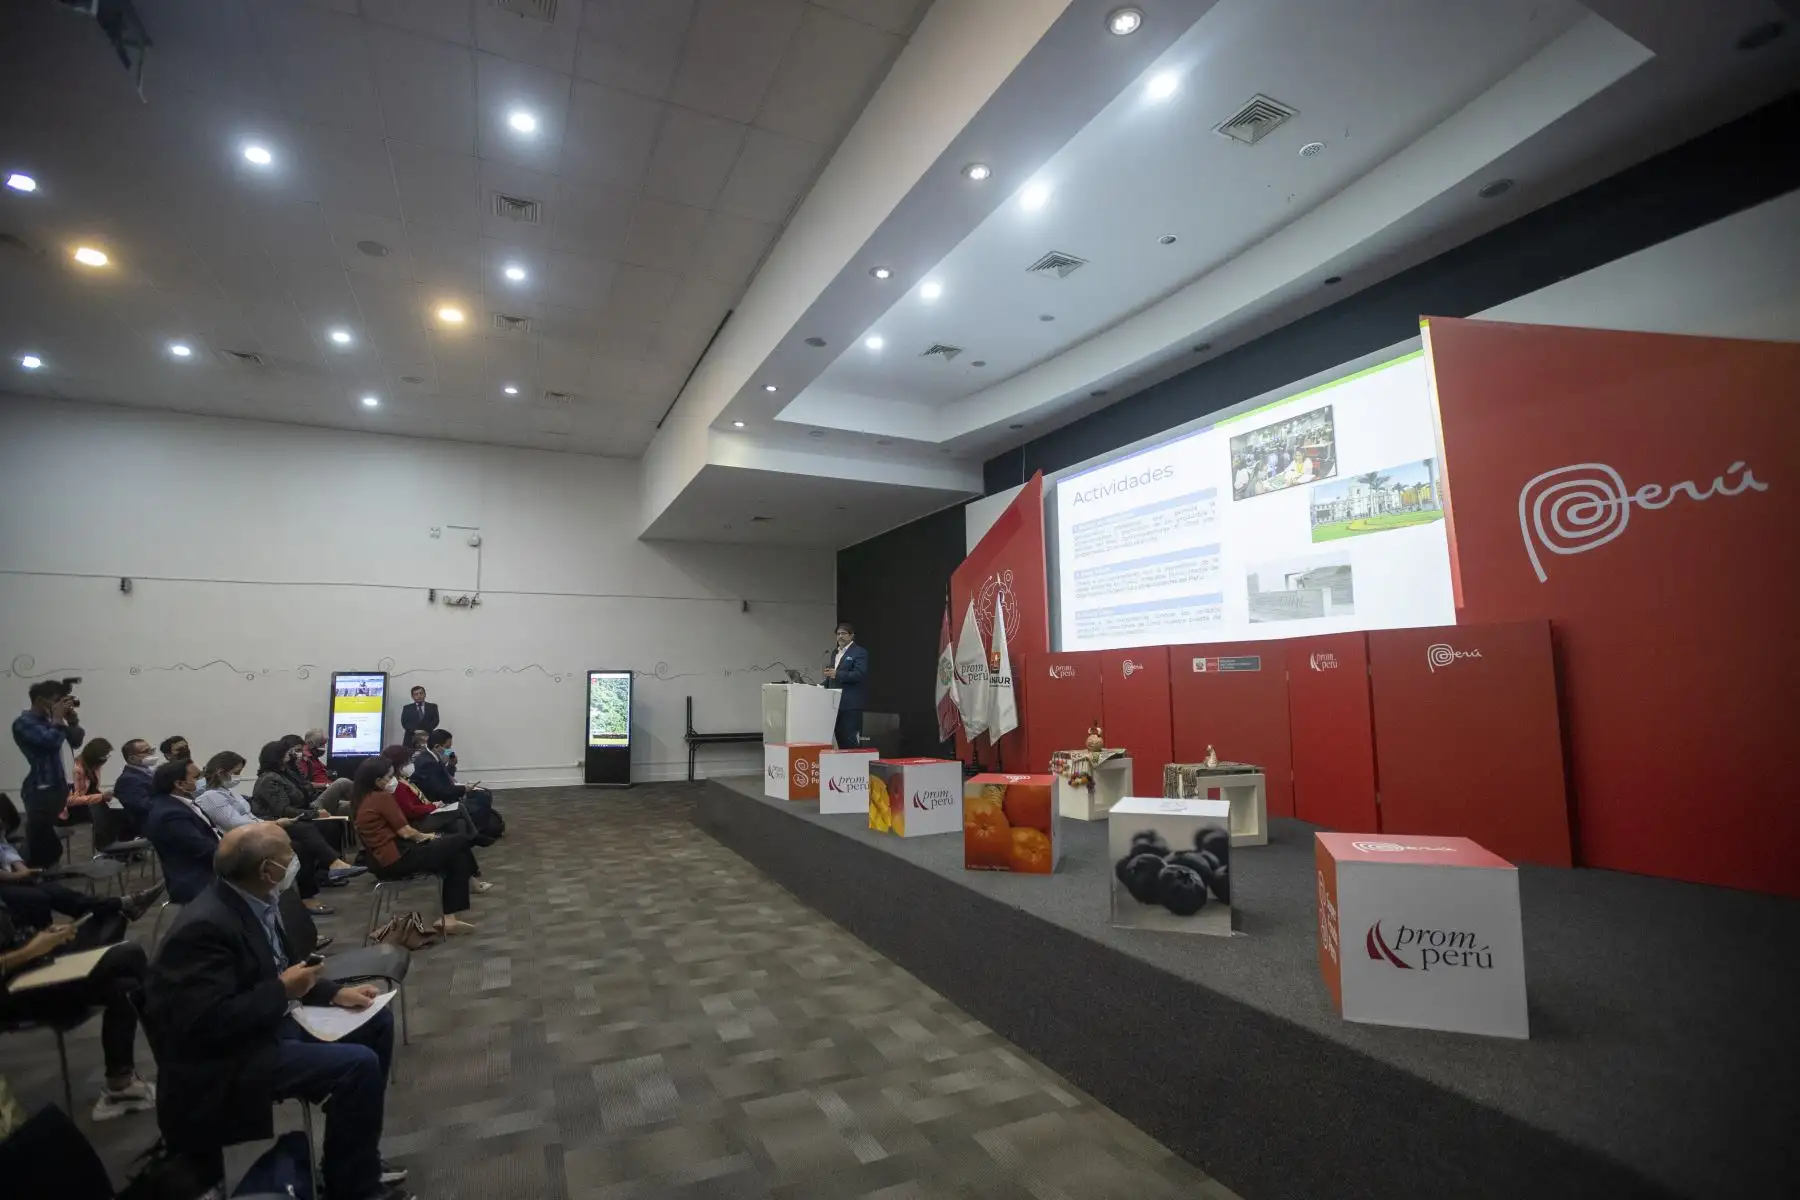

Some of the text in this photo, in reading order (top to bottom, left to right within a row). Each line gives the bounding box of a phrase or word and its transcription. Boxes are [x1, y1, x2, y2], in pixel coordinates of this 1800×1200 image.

[1073, 464, 1174, 506] Actividades
[961, 663, 984, 677] prom
[838, 776, 865, 786] prom
[922, 789, 949, 803] prom
[1393, 924, 1478, 951] prom
[1421, 945, 1494, 971] perú
